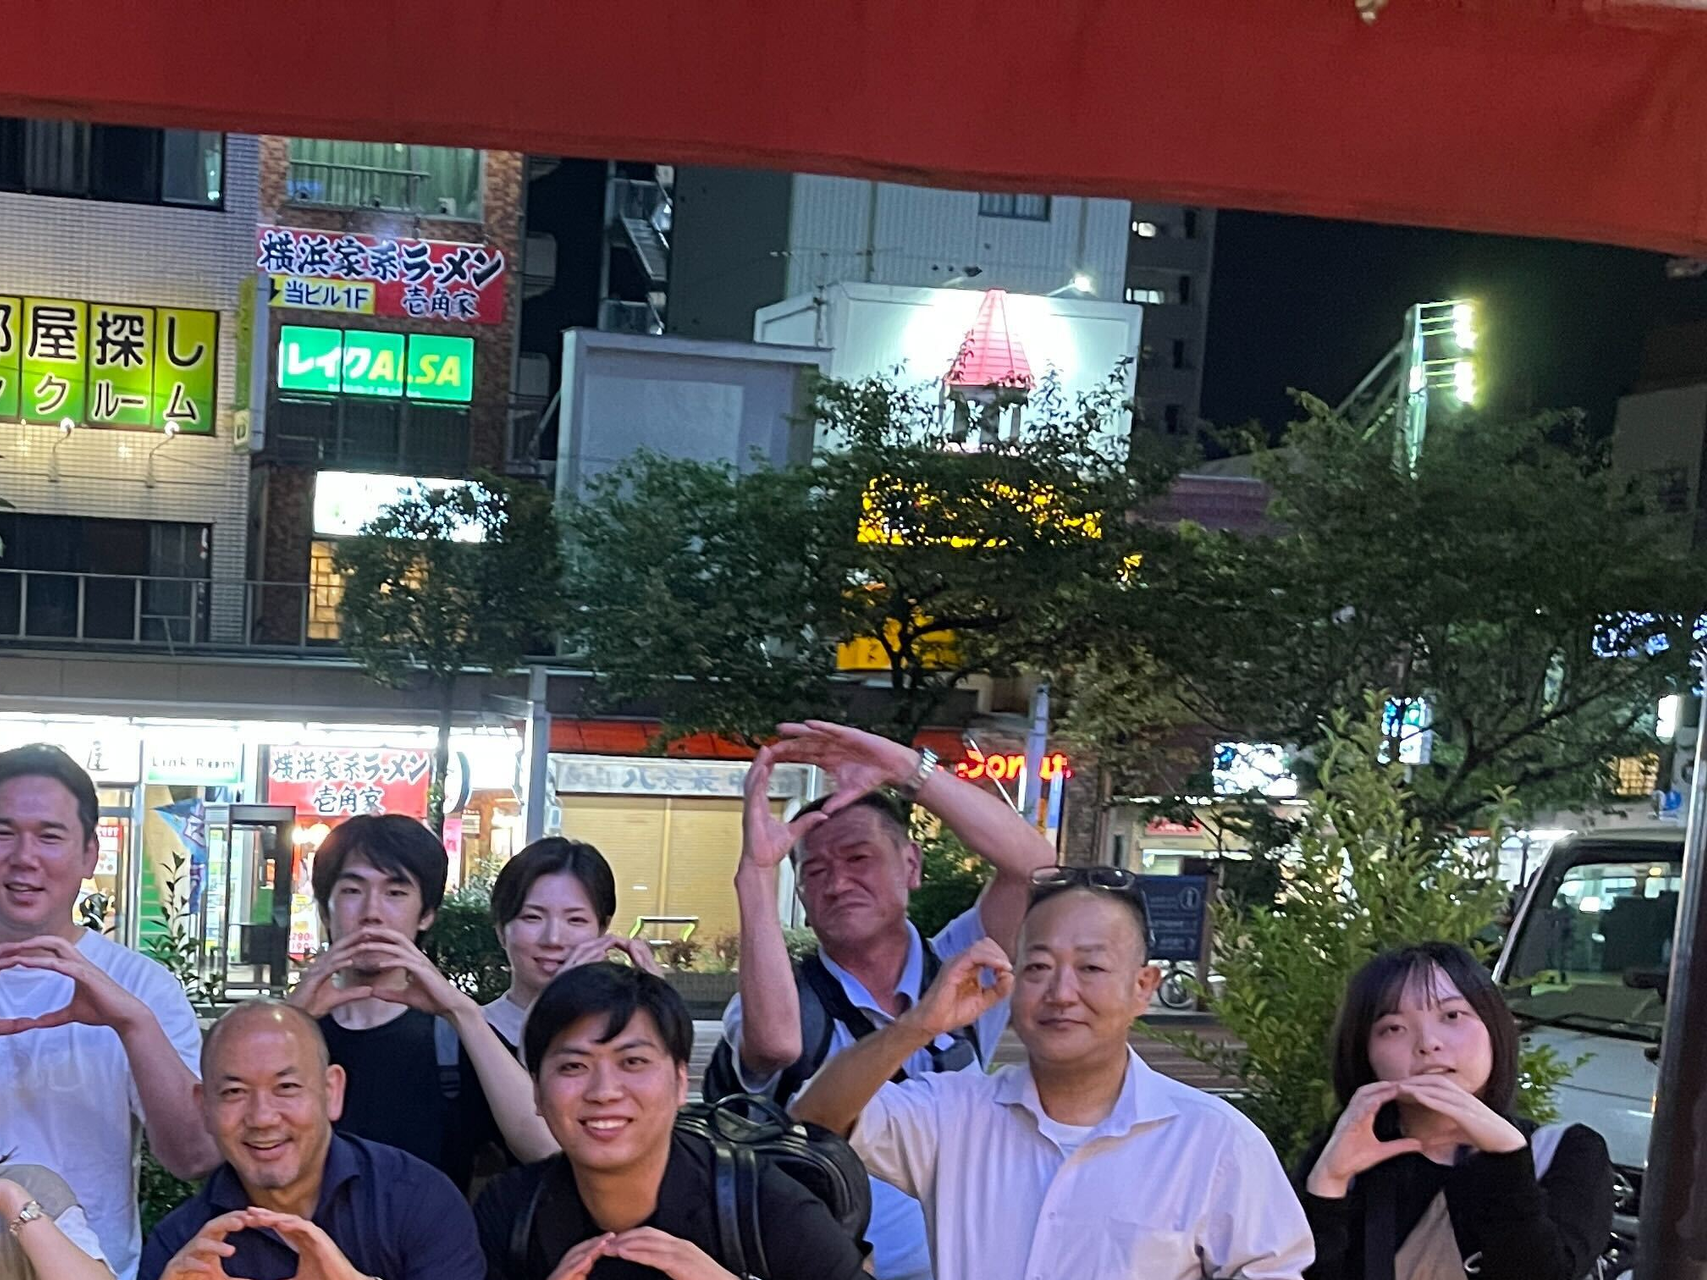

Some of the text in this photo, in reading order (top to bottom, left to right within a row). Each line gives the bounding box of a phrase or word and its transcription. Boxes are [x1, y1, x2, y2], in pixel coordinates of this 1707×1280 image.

[258, 231, 505, 290] 横浜家系ラーメン
[285, 280, 369, 309] 当ビル1F
[402, 286, 480, 320] 壱角家
[272, 751, 430, 782] 横浜家系ラーメン
[314, 784, 384, 814] 壱角家
